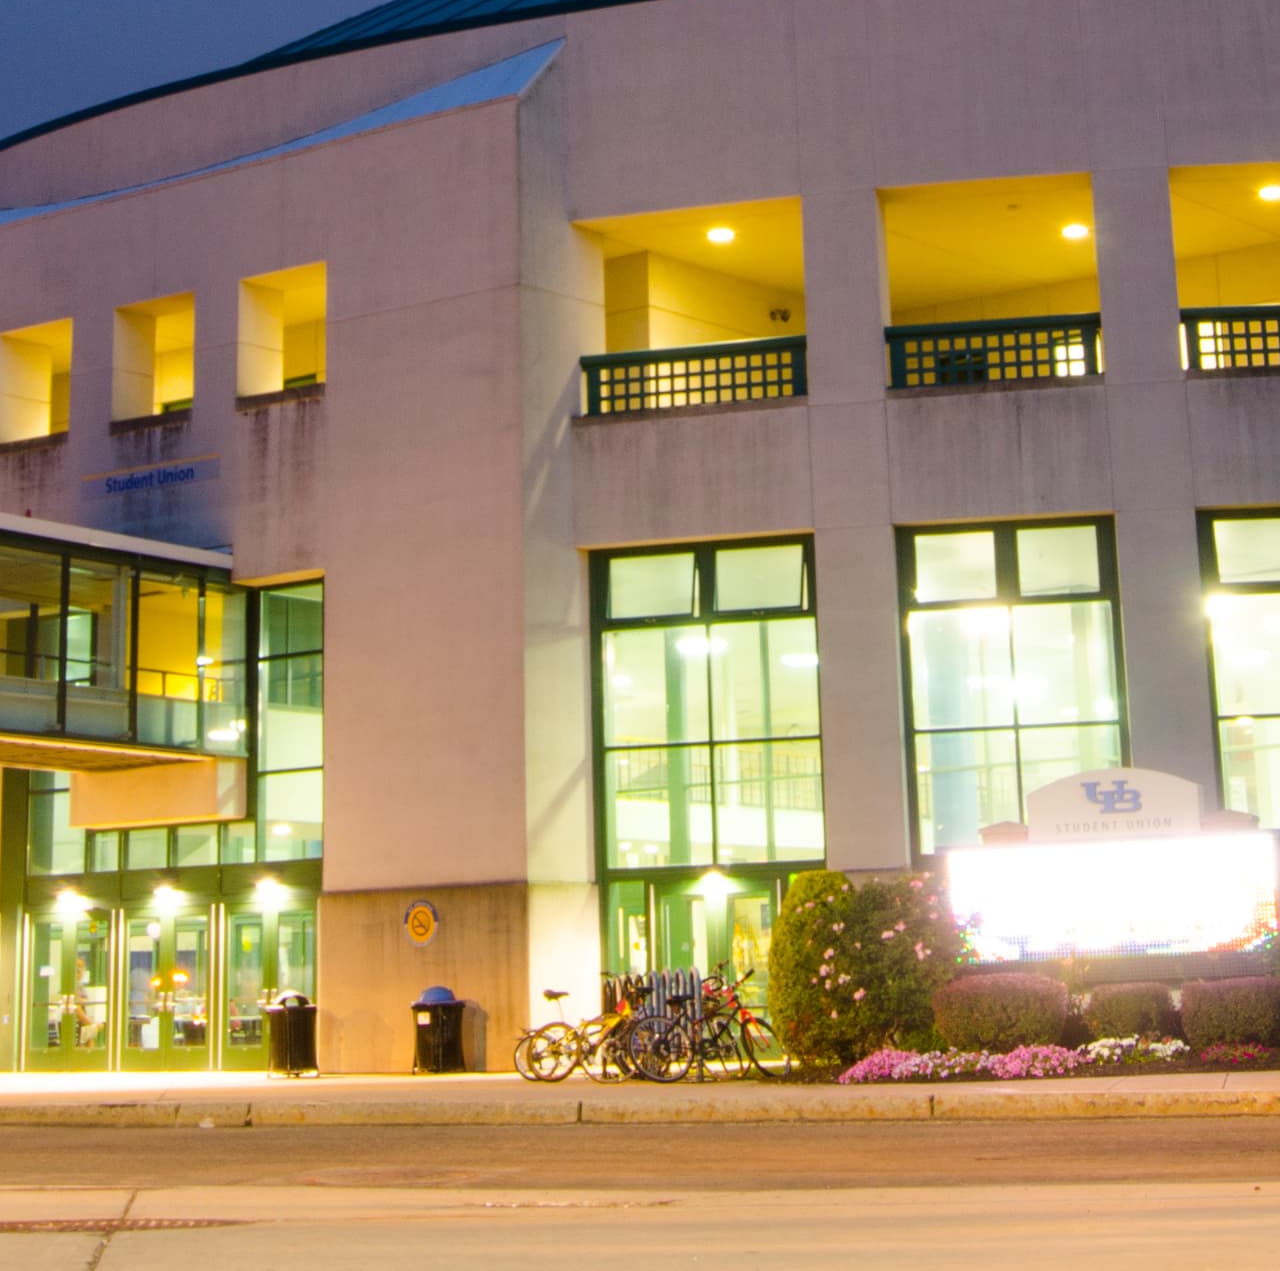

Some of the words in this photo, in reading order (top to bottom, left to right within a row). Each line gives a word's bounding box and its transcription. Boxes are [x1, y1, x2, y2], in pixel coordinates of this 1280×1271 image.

[105, 471, 153, 494] Student
[157, 466, 194, 484] Union
[1080, 779, 1143, 814] UB
[1055, 820, 1118, 833] STUDENT
[1126, 817, 1172, 830] UNION
